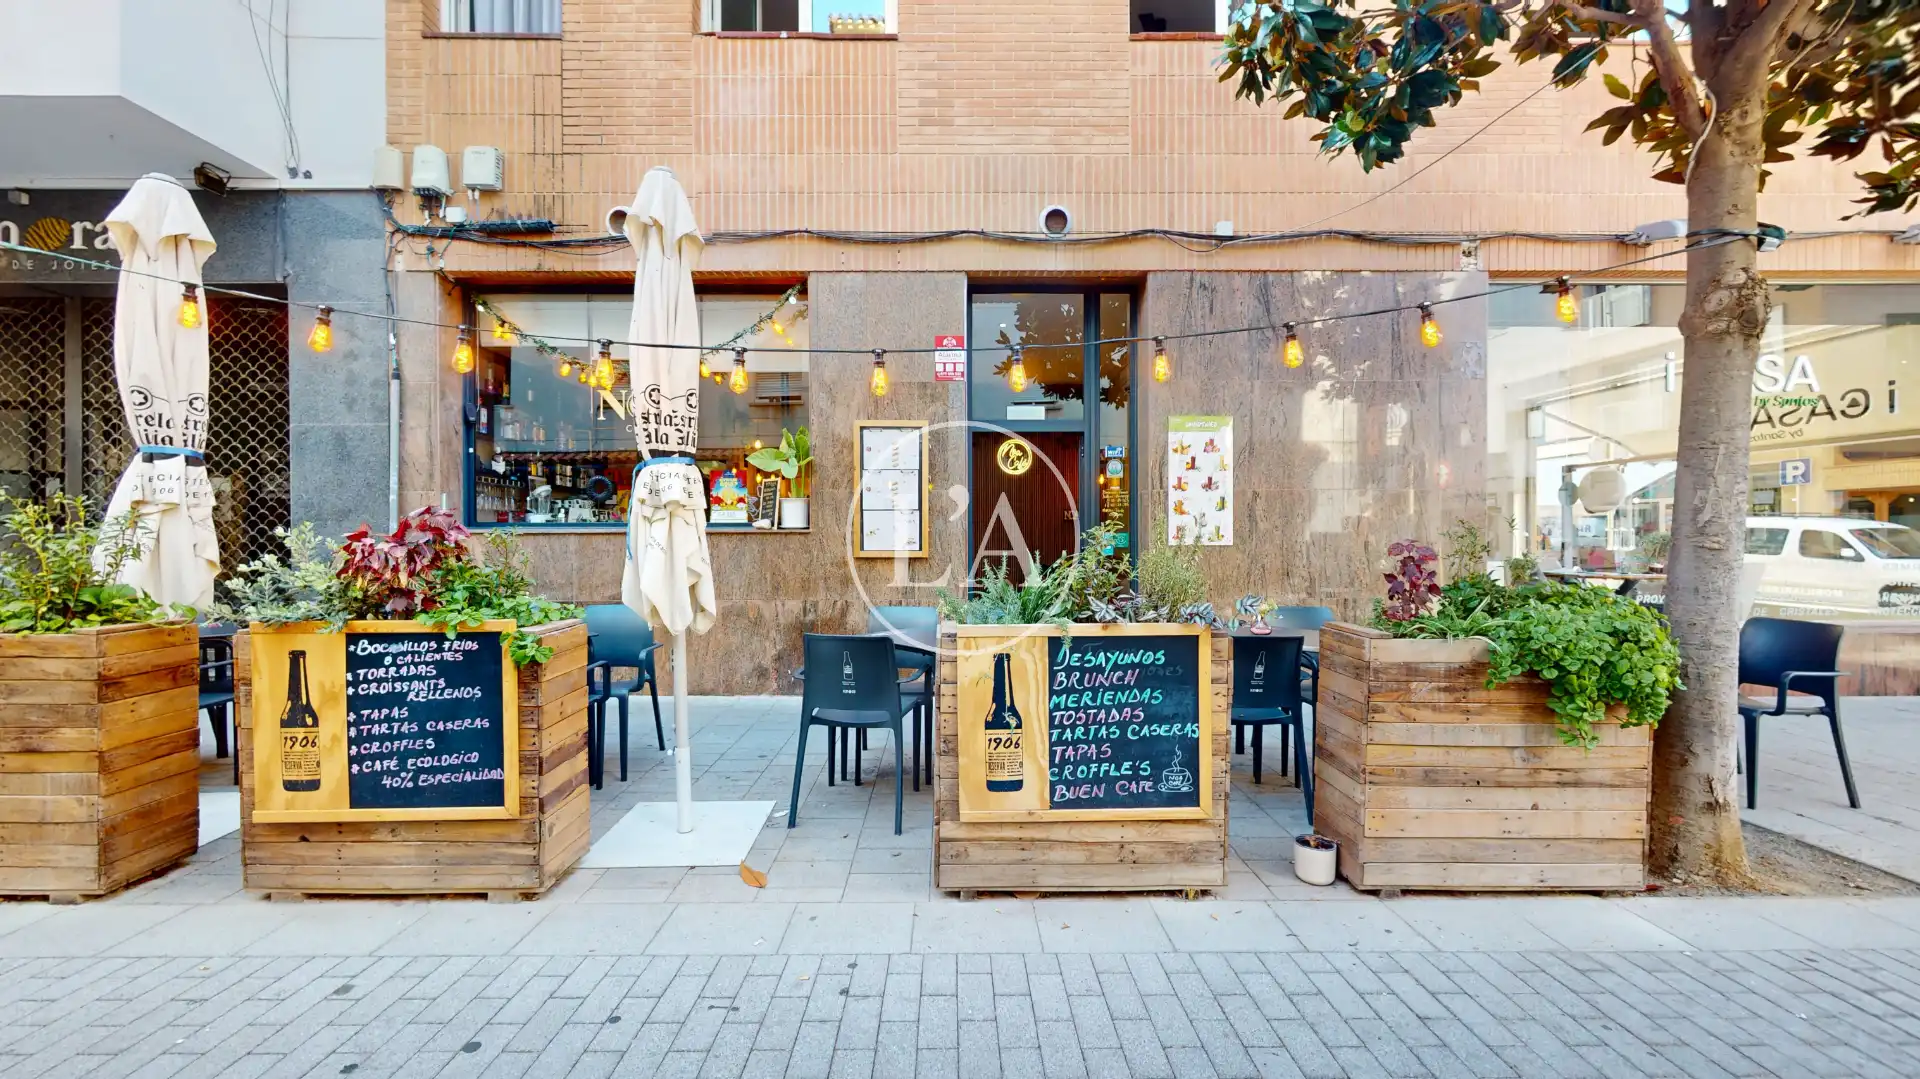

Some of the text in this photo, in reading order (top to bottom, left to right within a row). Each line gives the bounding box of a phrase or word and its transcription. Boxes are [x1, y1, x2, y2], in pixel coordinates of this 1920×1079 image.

[12, 258, 112, 270] DE JOIES
[1752, 354, 1821, 393] SA
[396, 651, 464, 665] CALIENTES
[1053, 643, 1166, 678] DESAYUNOS
[356, 665, 437, 681] TORRADAS
[1053, 668, 1140, 690] BRUNCH
[358, 678, 446, 695] CROISSANTS
[407, 686, 482, 702] RELLENOS
[1049, 688, 1163, 710] MERIENDAS
[360, 706, 409, 721] TAPAS
[1052, 707, 1145, 725] TOSTADAS
[360, 717, 490, 737] TARTAS CASERAS
[1049, 723, 1199, 742] TARTAS CASERAS
[284, 734, 318, 750] 1906
[360, 737, 436, 754] CROFFLES
[988, 736, 1021, 751] 1906
[1052, 743, 1112, 764] TAPAS
[362, 756, 400, 773] CAFÉ
[1048, 760, 1152, 781] CROFFLE'S
[381, 767, 505, 789] 40% ESPECIALIDAD
[1053, 777, 1156, 802] BUEN CAFÉ
